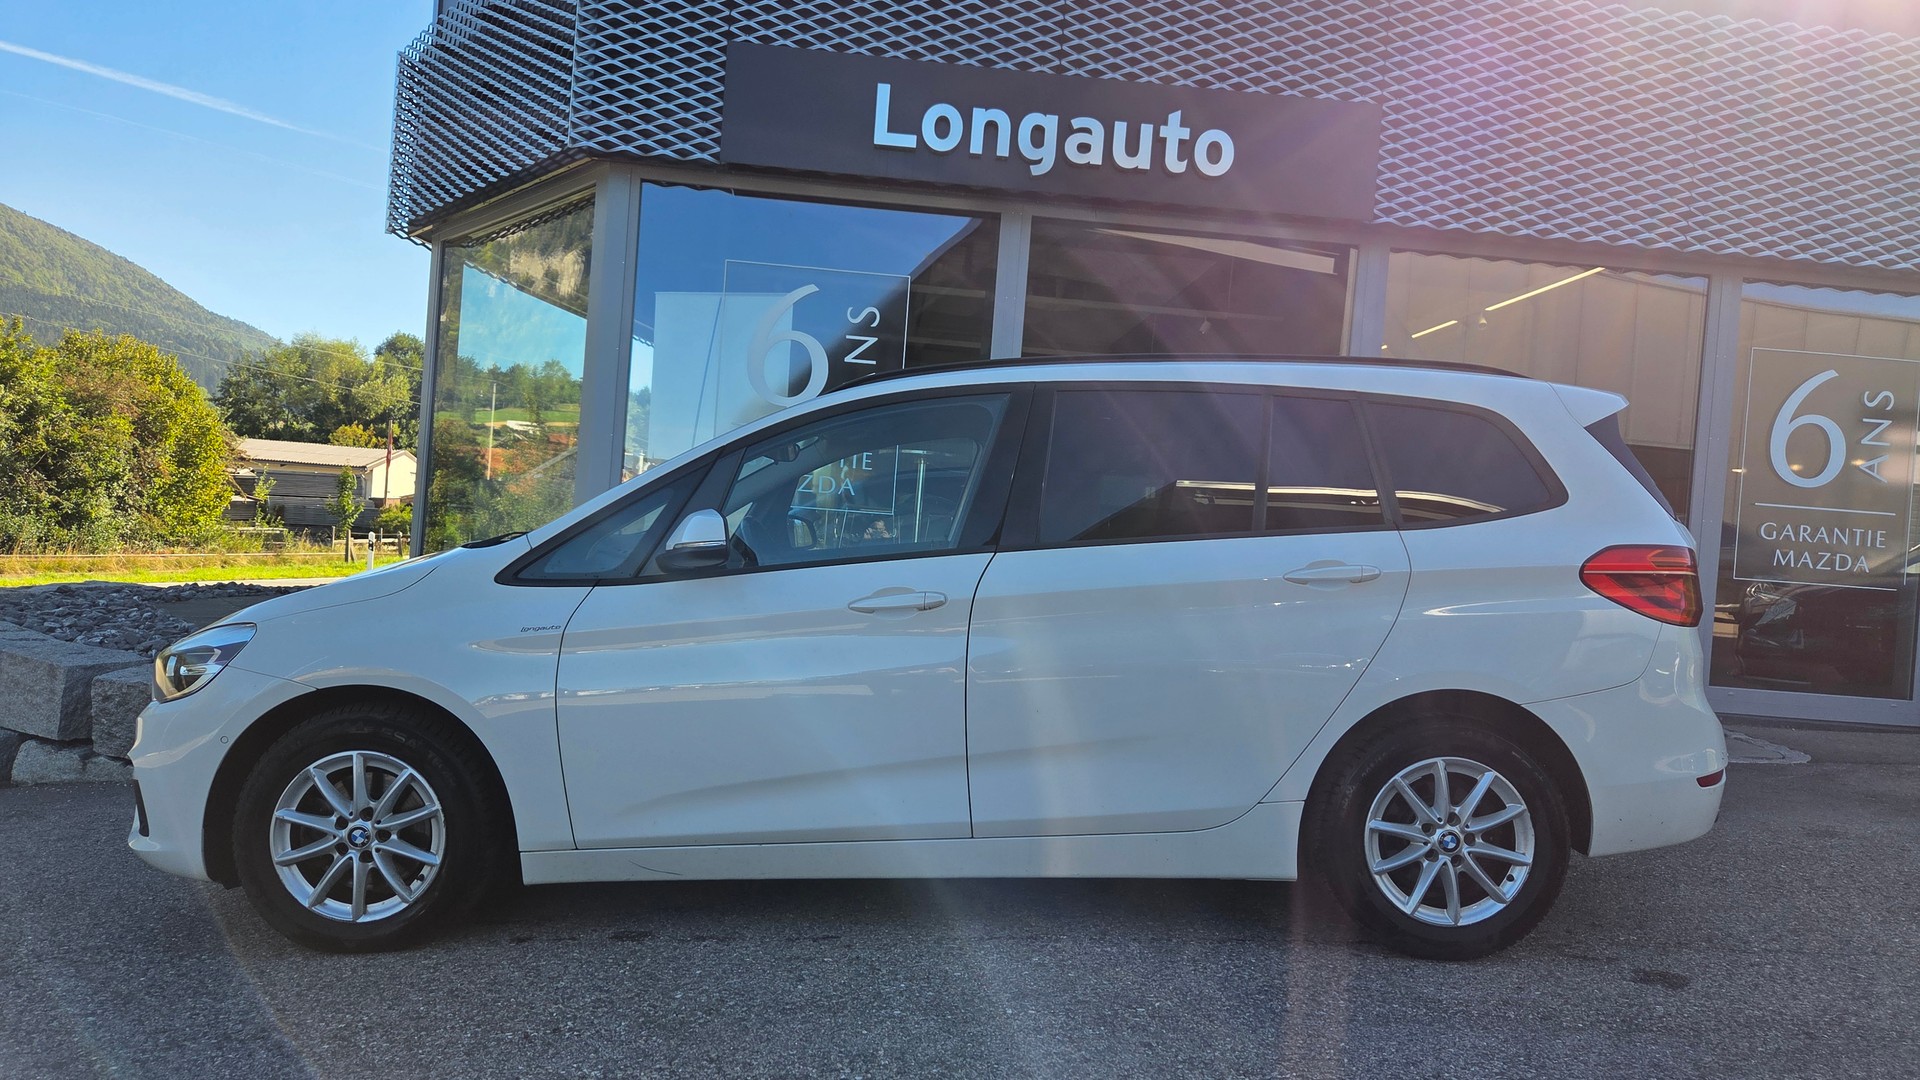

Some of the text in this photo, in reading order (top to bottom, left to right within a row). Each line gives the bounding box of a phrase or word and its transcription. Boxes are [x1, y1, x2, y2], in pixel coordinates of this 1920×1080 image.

[873, 83, 1235, 177] Longauto
[747, 284, 829, 408] 6
[843, 306, 881, 375] NS
[1770, 369, 1846, 488] 6
[1859, 390, 1895, 483] ANS
[798, 474, 855, 495] ZDA
[1760, 521, 1887, 548] GARANTIE
[1773, 549, 1871, 573] MAZDA
